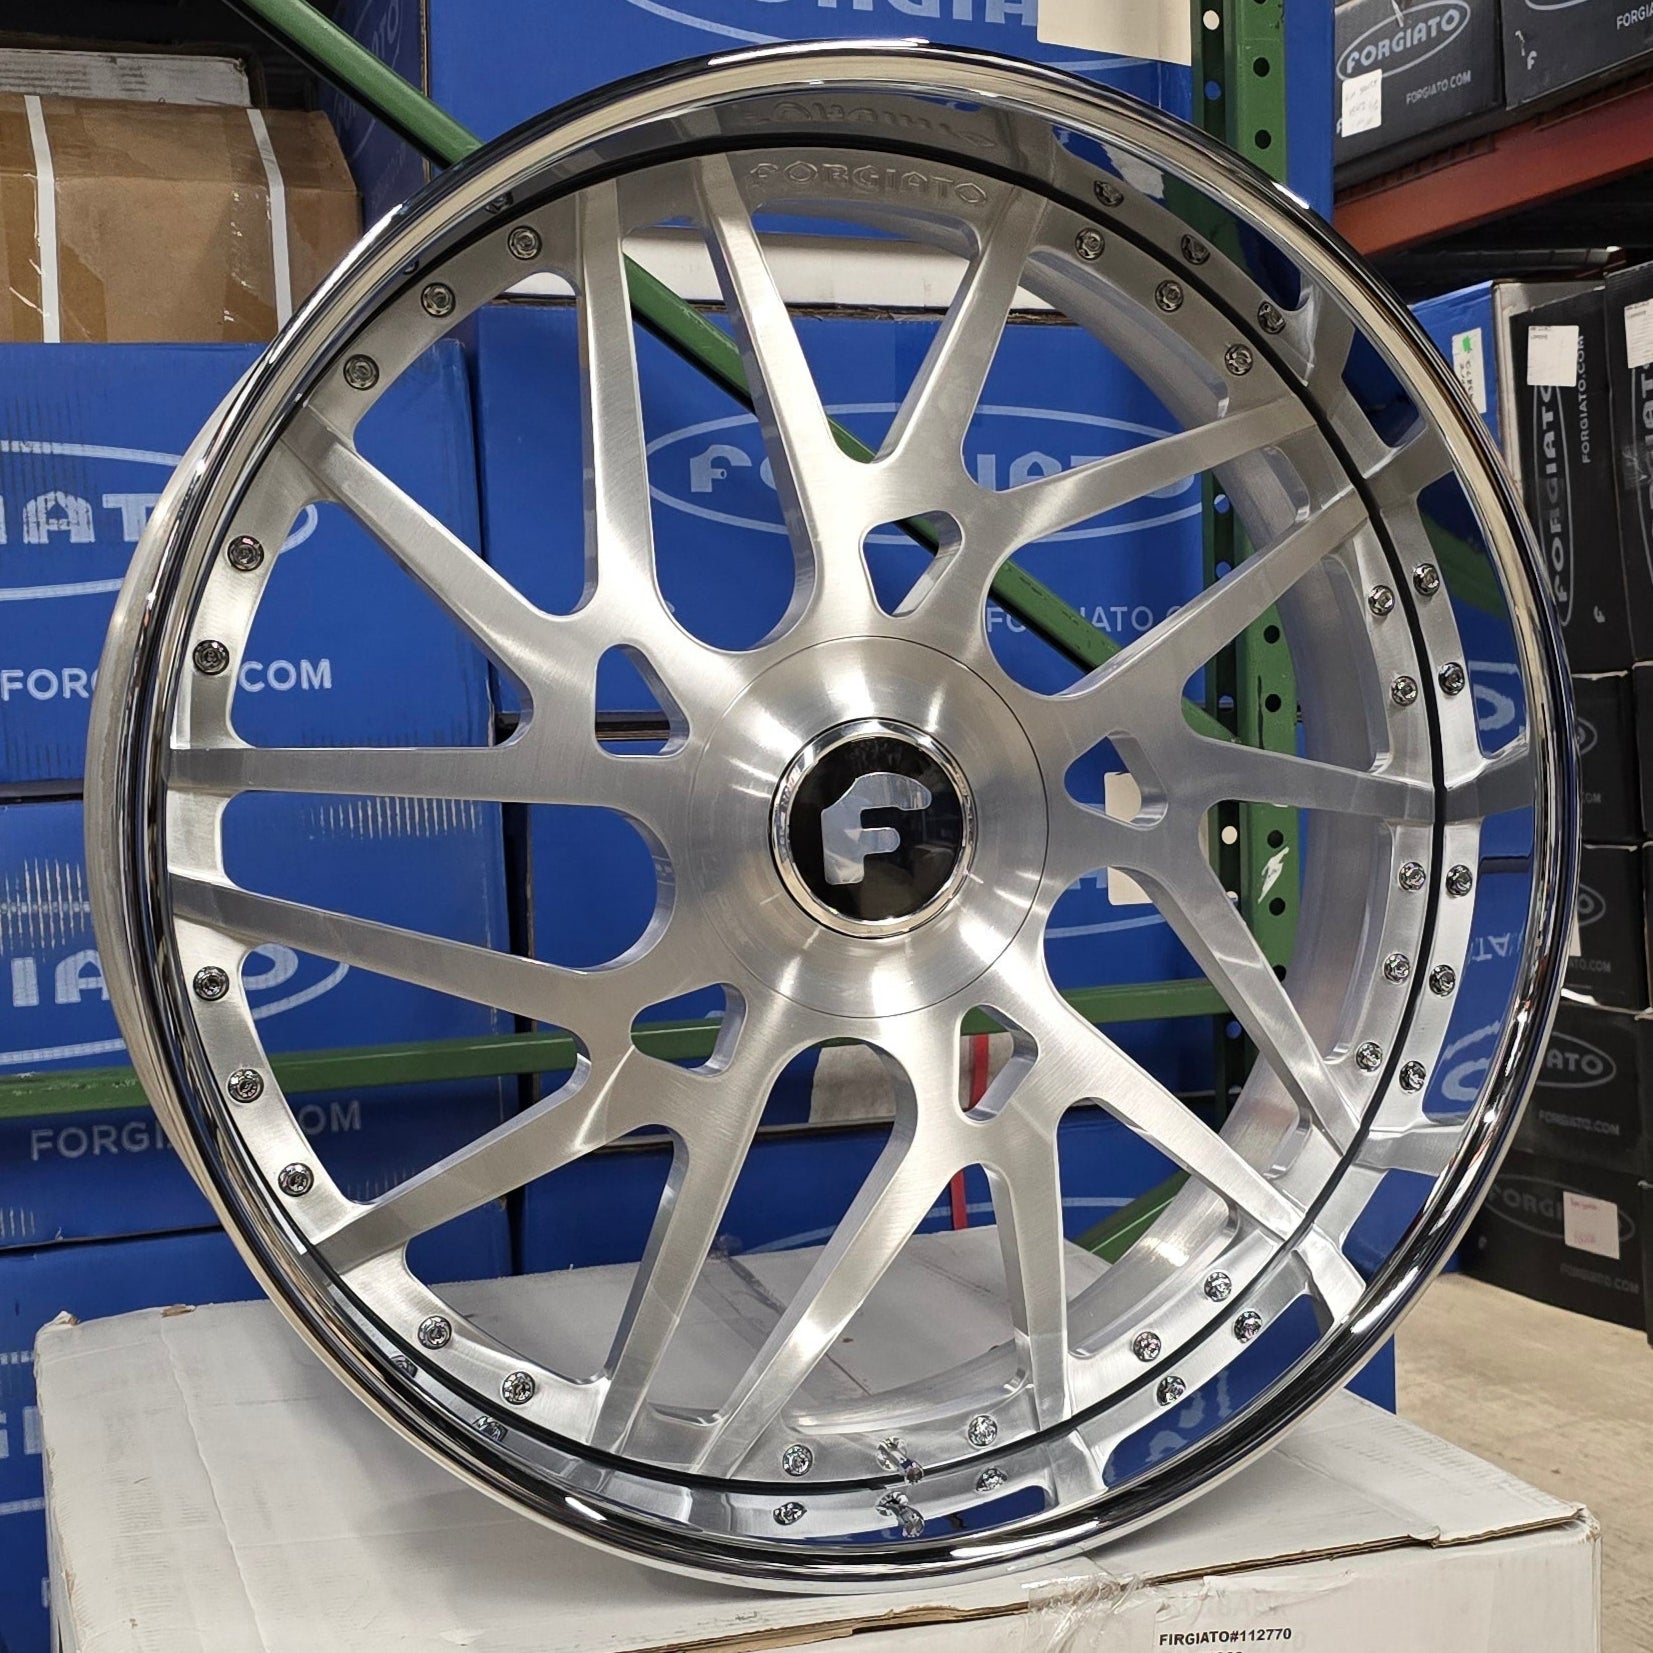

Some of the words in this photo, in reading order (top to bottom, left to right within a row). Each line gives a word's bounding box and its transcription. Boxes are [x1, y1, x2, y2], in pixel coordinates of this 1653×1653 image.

[1346, 9, 1460, 74] FORGIATO
[1406, 70, 1471, 104] FORGIATO.COM
[750, 160, 987, 203] FORGIATO
[1578, 335, 1591, 463] FORGIATO.COM
[821, 772, 932, 885] F
[1159, 1628, 1292, 1645] FIRGIATO#112770
